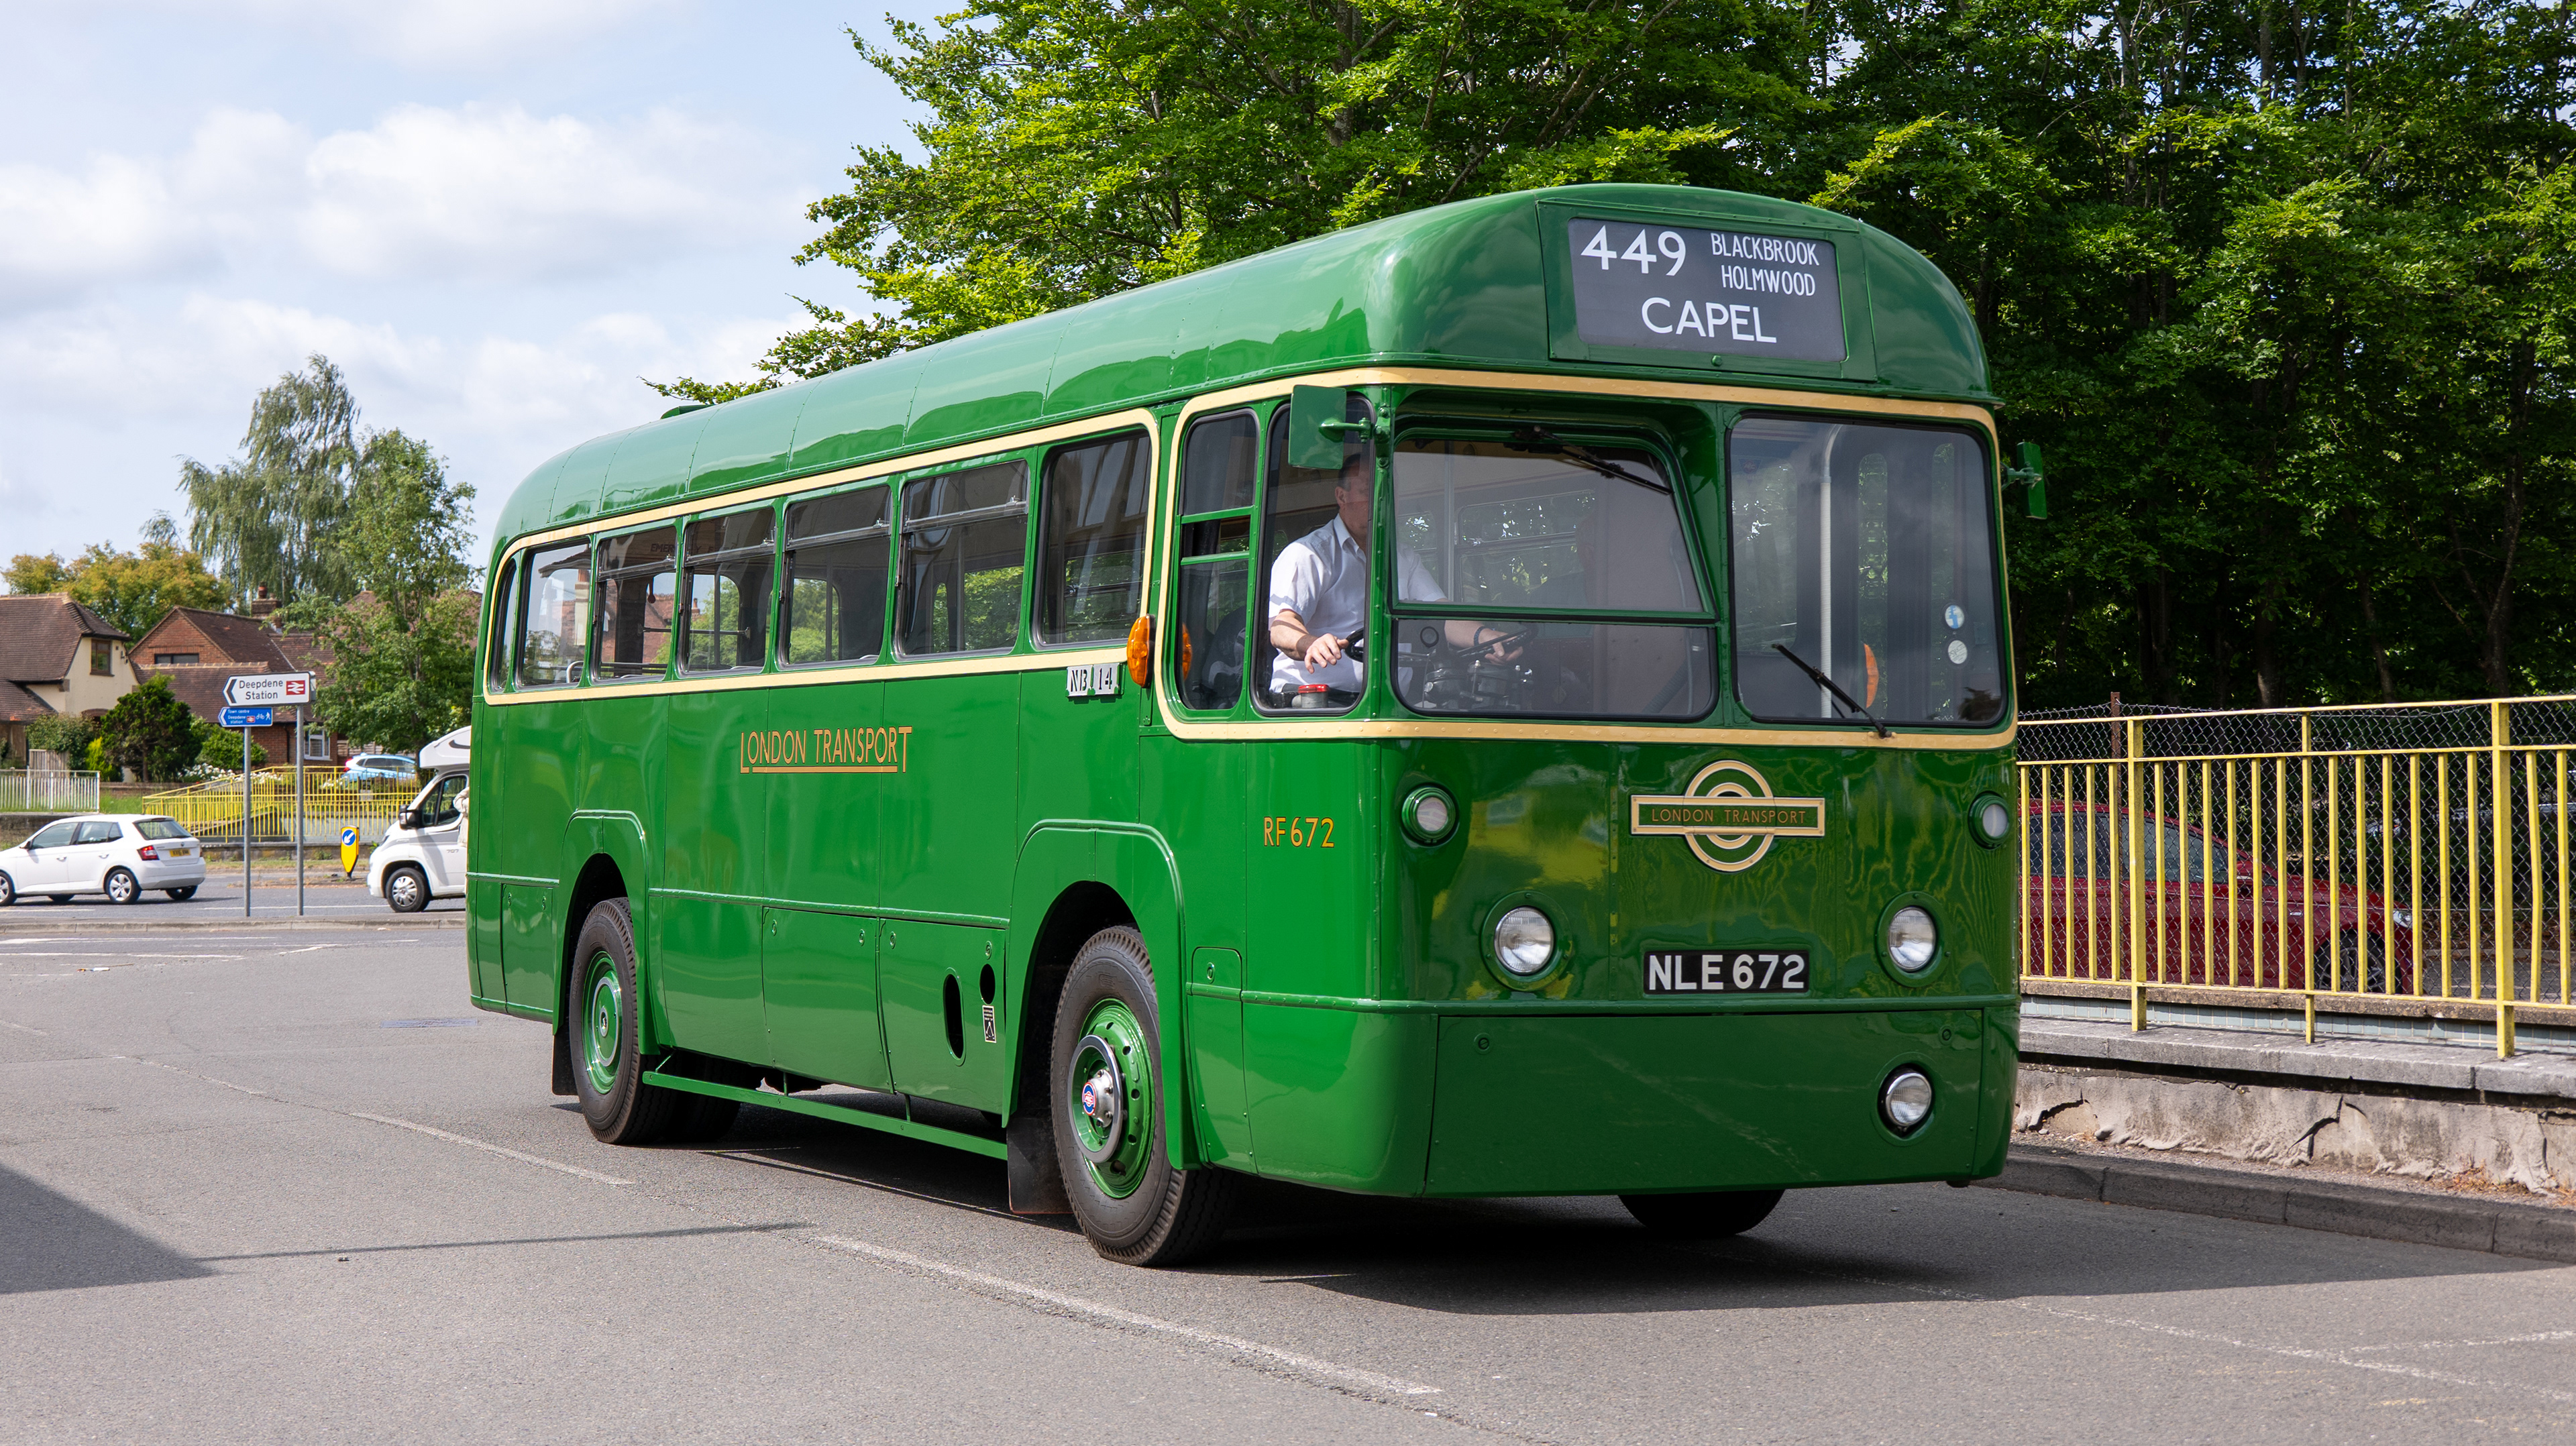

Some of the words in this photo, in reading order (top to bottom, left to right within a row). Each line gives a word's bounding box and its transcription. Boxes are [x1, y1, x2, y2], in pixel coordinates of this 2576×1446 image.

[1580, 225, 1686, 276] 449
[1710, 233, 1819, 266] BLACKBROOK
[1721, 265, 1815, 296] HOLMWOOD
[1642, 297, 1777, 343] CAPEL
[239, 679, 283, 689] Deepdene
[246, 691, 278, 700] Station
[1071, 669, 1087, 692] NB
[1099, 667, 1112, 690] 14
[741, 729, 806, 773] LONDON
[814, 726, 912, 773] TRANSPORT
[1651, 808, 1714, 822] LONDON
[1724, 809, 1806, 824] TRANSPORT
[1649, 954, 1723, 990] NLE
[1732, 954, 1805, 989] 672
